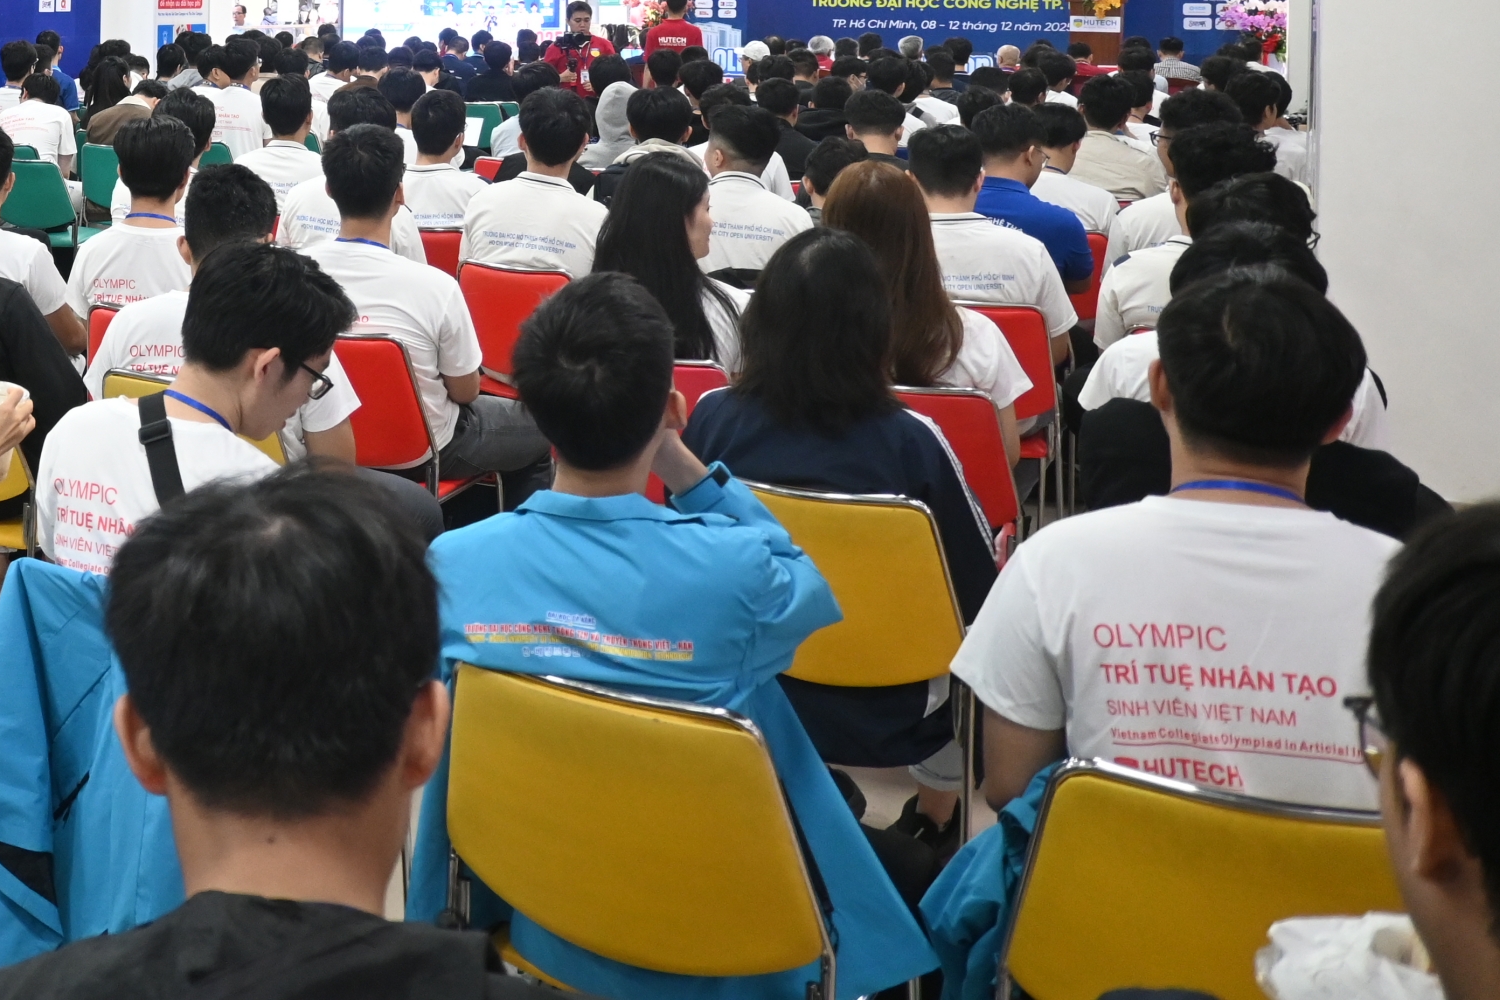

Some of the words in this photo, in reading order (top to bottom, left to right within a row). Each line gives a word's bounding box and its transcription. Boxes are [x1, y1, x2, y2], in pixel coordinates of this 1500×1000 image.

[832, 19, 847, 28] TP.
[849, 18, 866, 29] Hồ
[867, 18, 887, 29] Chí
[888, 19, 918, 31] Minh,
[921, 20, 936, 30] 08
[947, 20, 960, 30] 12
[962, 20, 998, 33] tháng
[1000, 21, 1012, 31] 12
[1014, 21, 1042, 31] năm
[658, 36, 687, 44] HUTECH
[744, 233, 774, 242] UNIVERSITY
[538, 244, 566, 254] UNIVERSITY
[93, 278, 136, 290] OLYMPIC
[973, 283, 1005, 291] UNIVERSITY
[130, 344, 187, 358] OLYMPIC
[53, 478, 118, 505] OLYMPIC
[57, 505, 69, 524] TRÍ
[70, 510, 94, 533] TUỆ
[54, 532, 69, 548] SINH
[69, 535, 93, 553] VIÊN
[68, 557, 102, 573] Collegiate
[1093, 623, 1227, 651] OLYMPIC
[1100, 659, 1139, 685] TRÍ
[1144, 663, 1195, 691] TUỆ
[1200, 665, 1275, 692] NHÂN
[1282, 673, 1337, 700] TẠO
[1106, 700, 1149, 716] SINH
[1153, 697, 1198, 719] VIÊN
[1202, 703, 1244, 724] VIỆT
[1250, 707, 1297, 727] NAM
[1110, 727, 1158, 740] Vietnam
[1158, 728, 1220, 745] Collegiate
[1221, 734, 1282, 751] Olympiad
[1285, 738, 1297, 750] in
[1142, 758, 1244, 788] HUTECH
